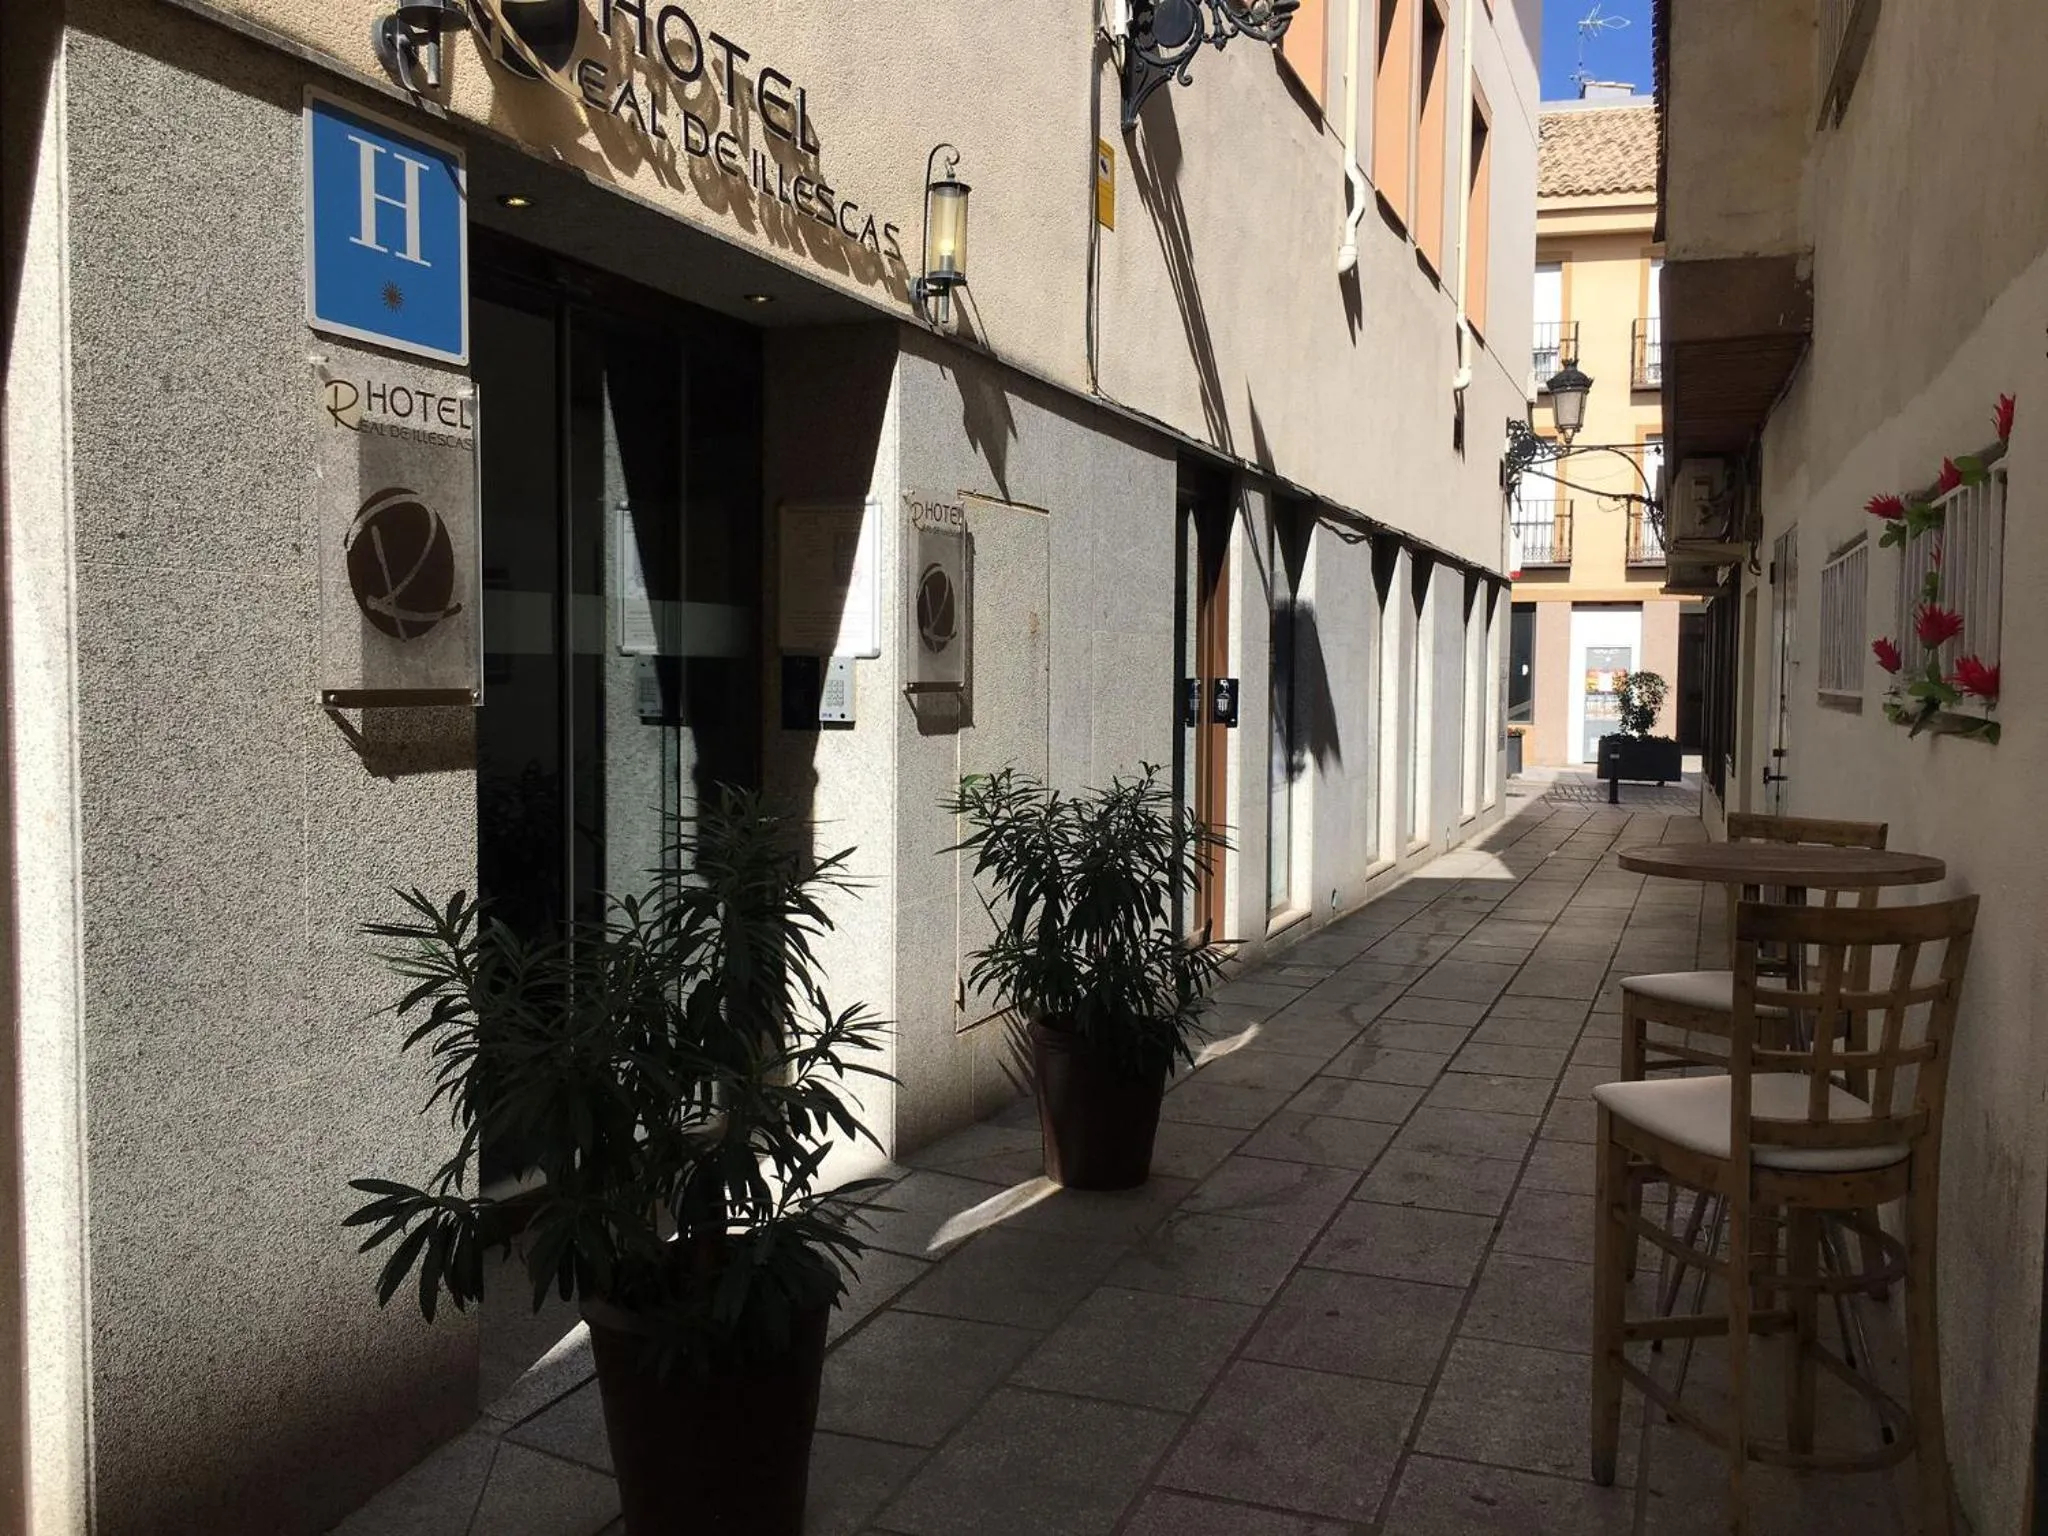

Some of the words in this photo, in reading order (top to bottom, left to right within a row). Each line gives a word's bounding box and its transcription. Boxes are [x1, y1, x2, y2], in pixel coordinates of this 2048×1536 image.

[600, 0, 820, 156] HOTEL
[348, 134, 432, 268] H
[680, 109, 738, 177] DE
[753, 148, 900, 262] ILLESCAS
[367, 380, 472, 430] HOTEL
[413, 429, 475, 451] ILLESCAS
